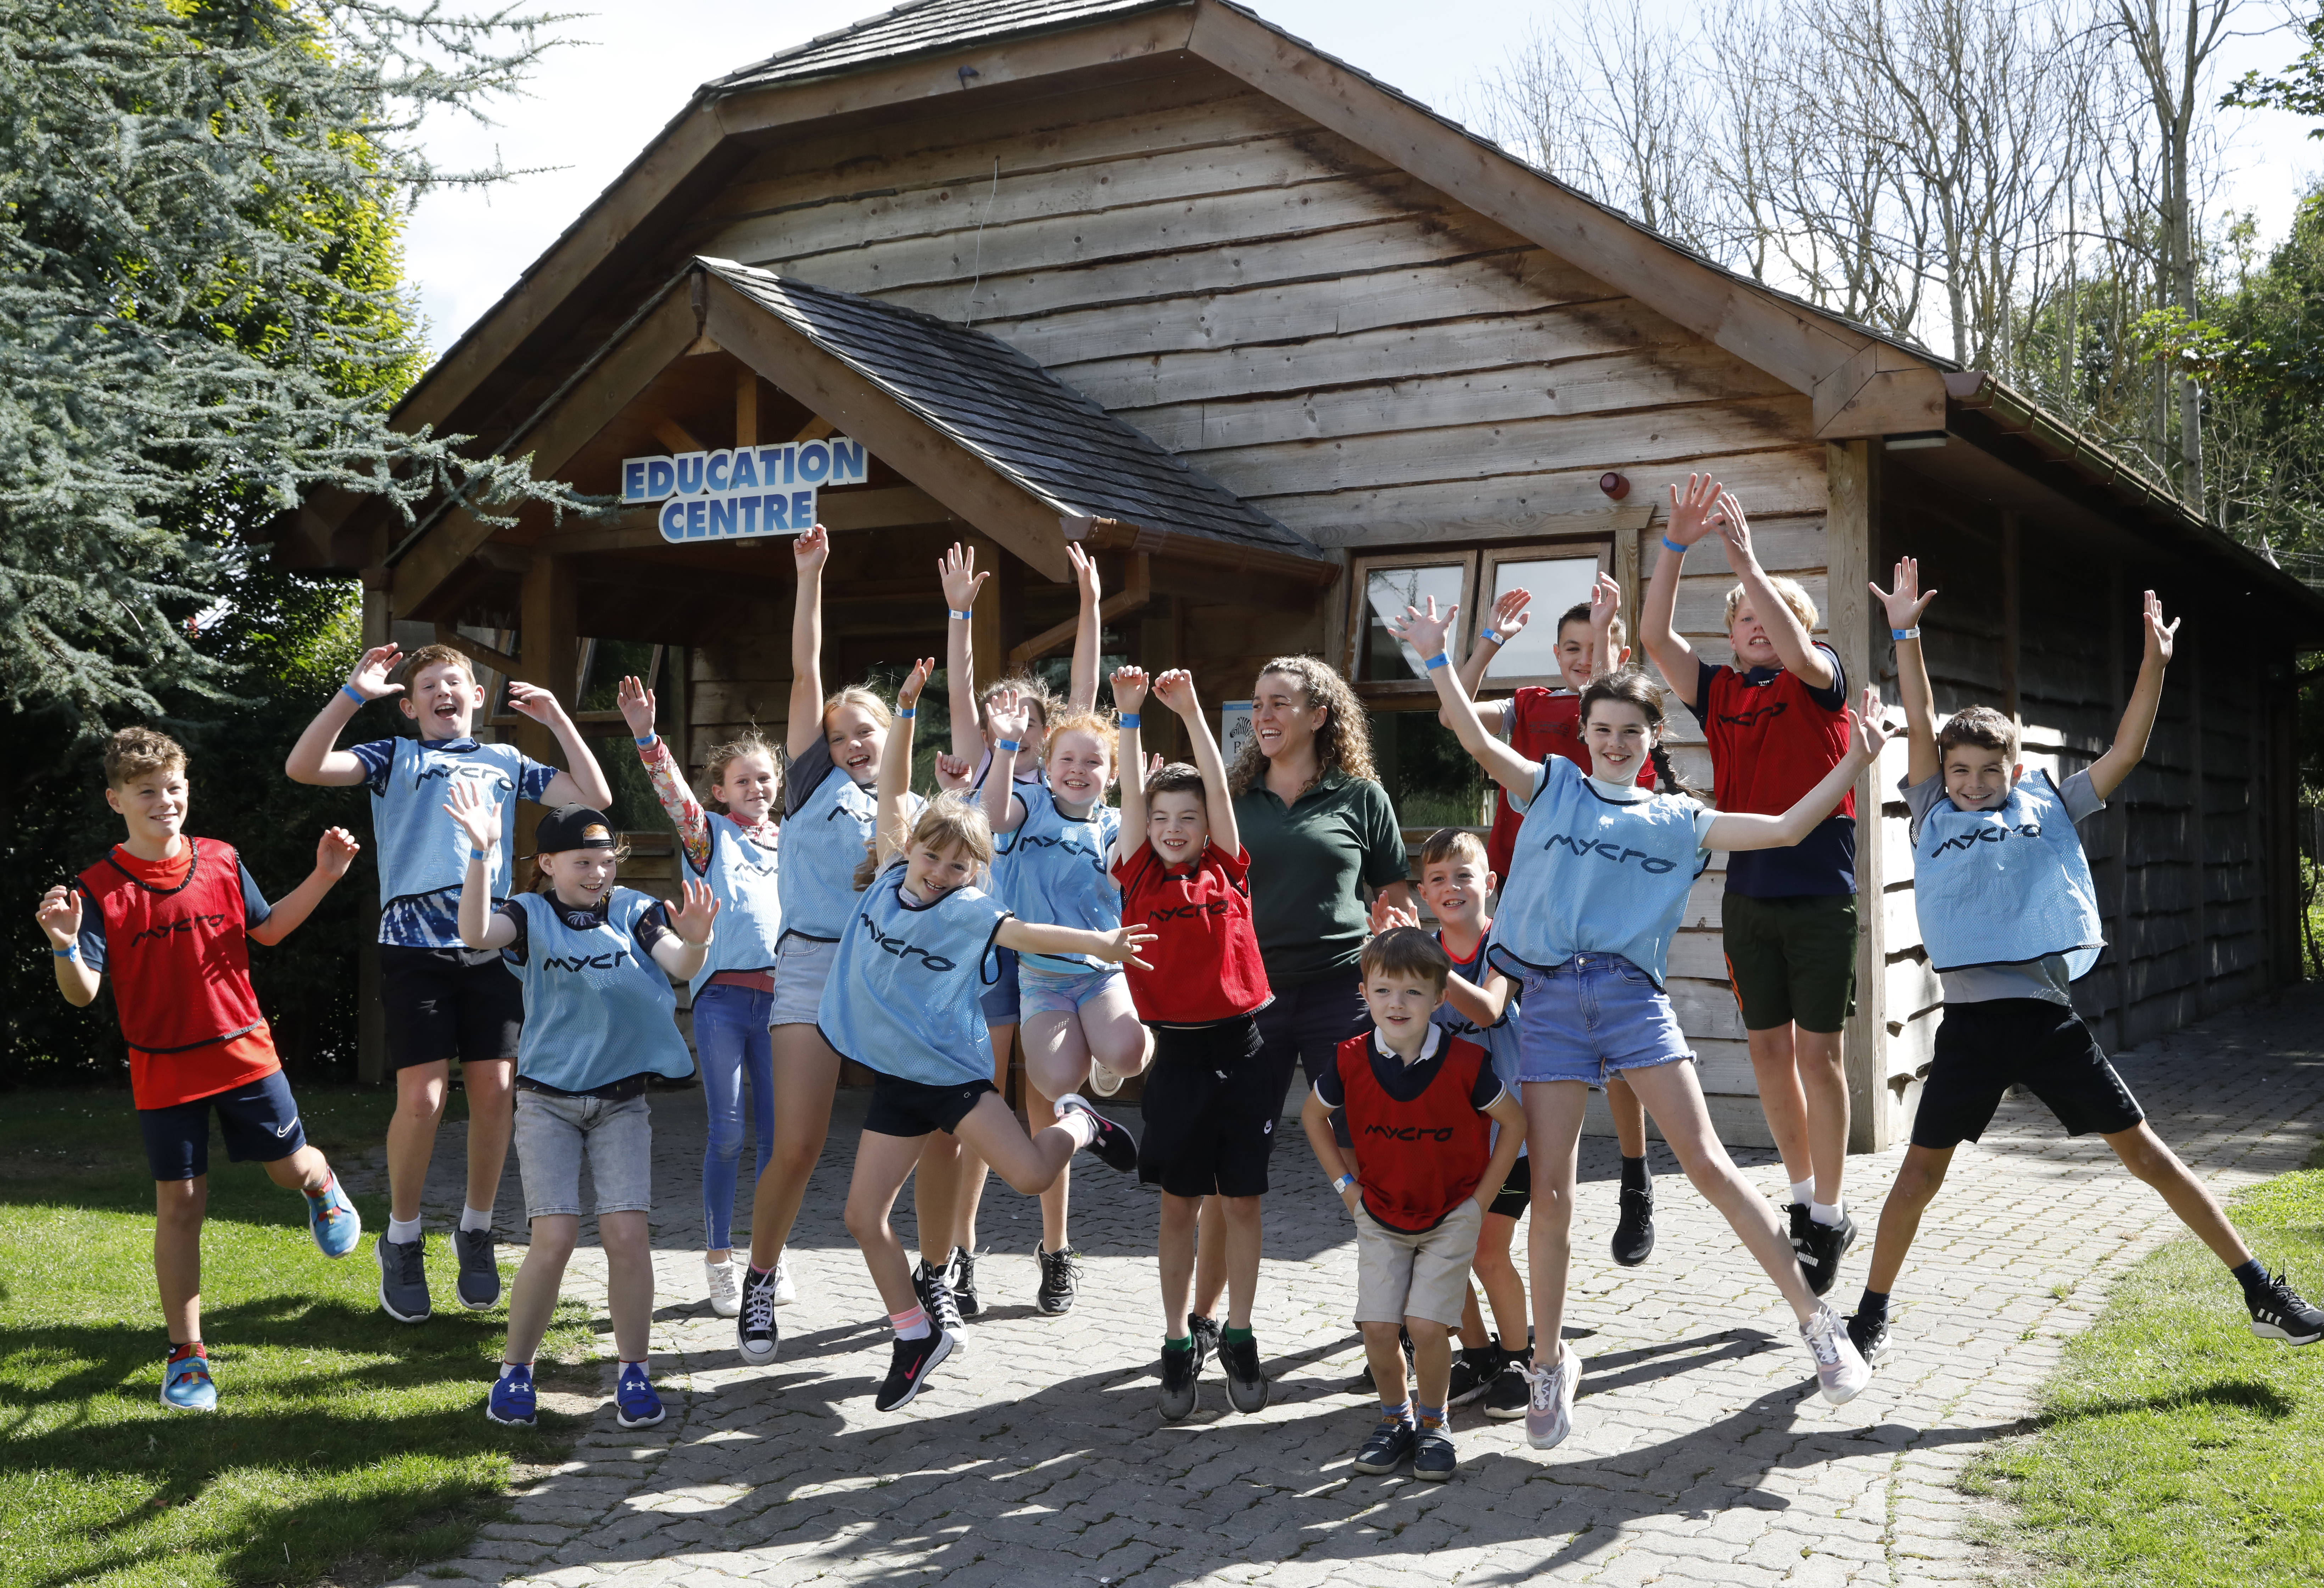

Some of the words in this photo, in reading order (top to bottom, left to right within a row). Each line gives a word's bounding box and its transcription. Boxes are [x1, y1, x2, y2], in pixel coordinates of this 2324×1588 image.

[626, 440, 863, 498] EDUCATION
[663, 491, 812, 539] CENTRE
[416, 764, 516, 791] mycro
[1544, 834, 1677, 873] mycro
[1932, 823, 2041, 858] mycro
[1148, 900, 1229, 923] mycro
[132, 914, 224, 947] mycro
[861, 913, 956, 972] mycro
[543, 950, 629, 972] mycr
[1365, 1124, 1454, 1142] mycro
[1797, 1251, 1819, 1267] PUMA
